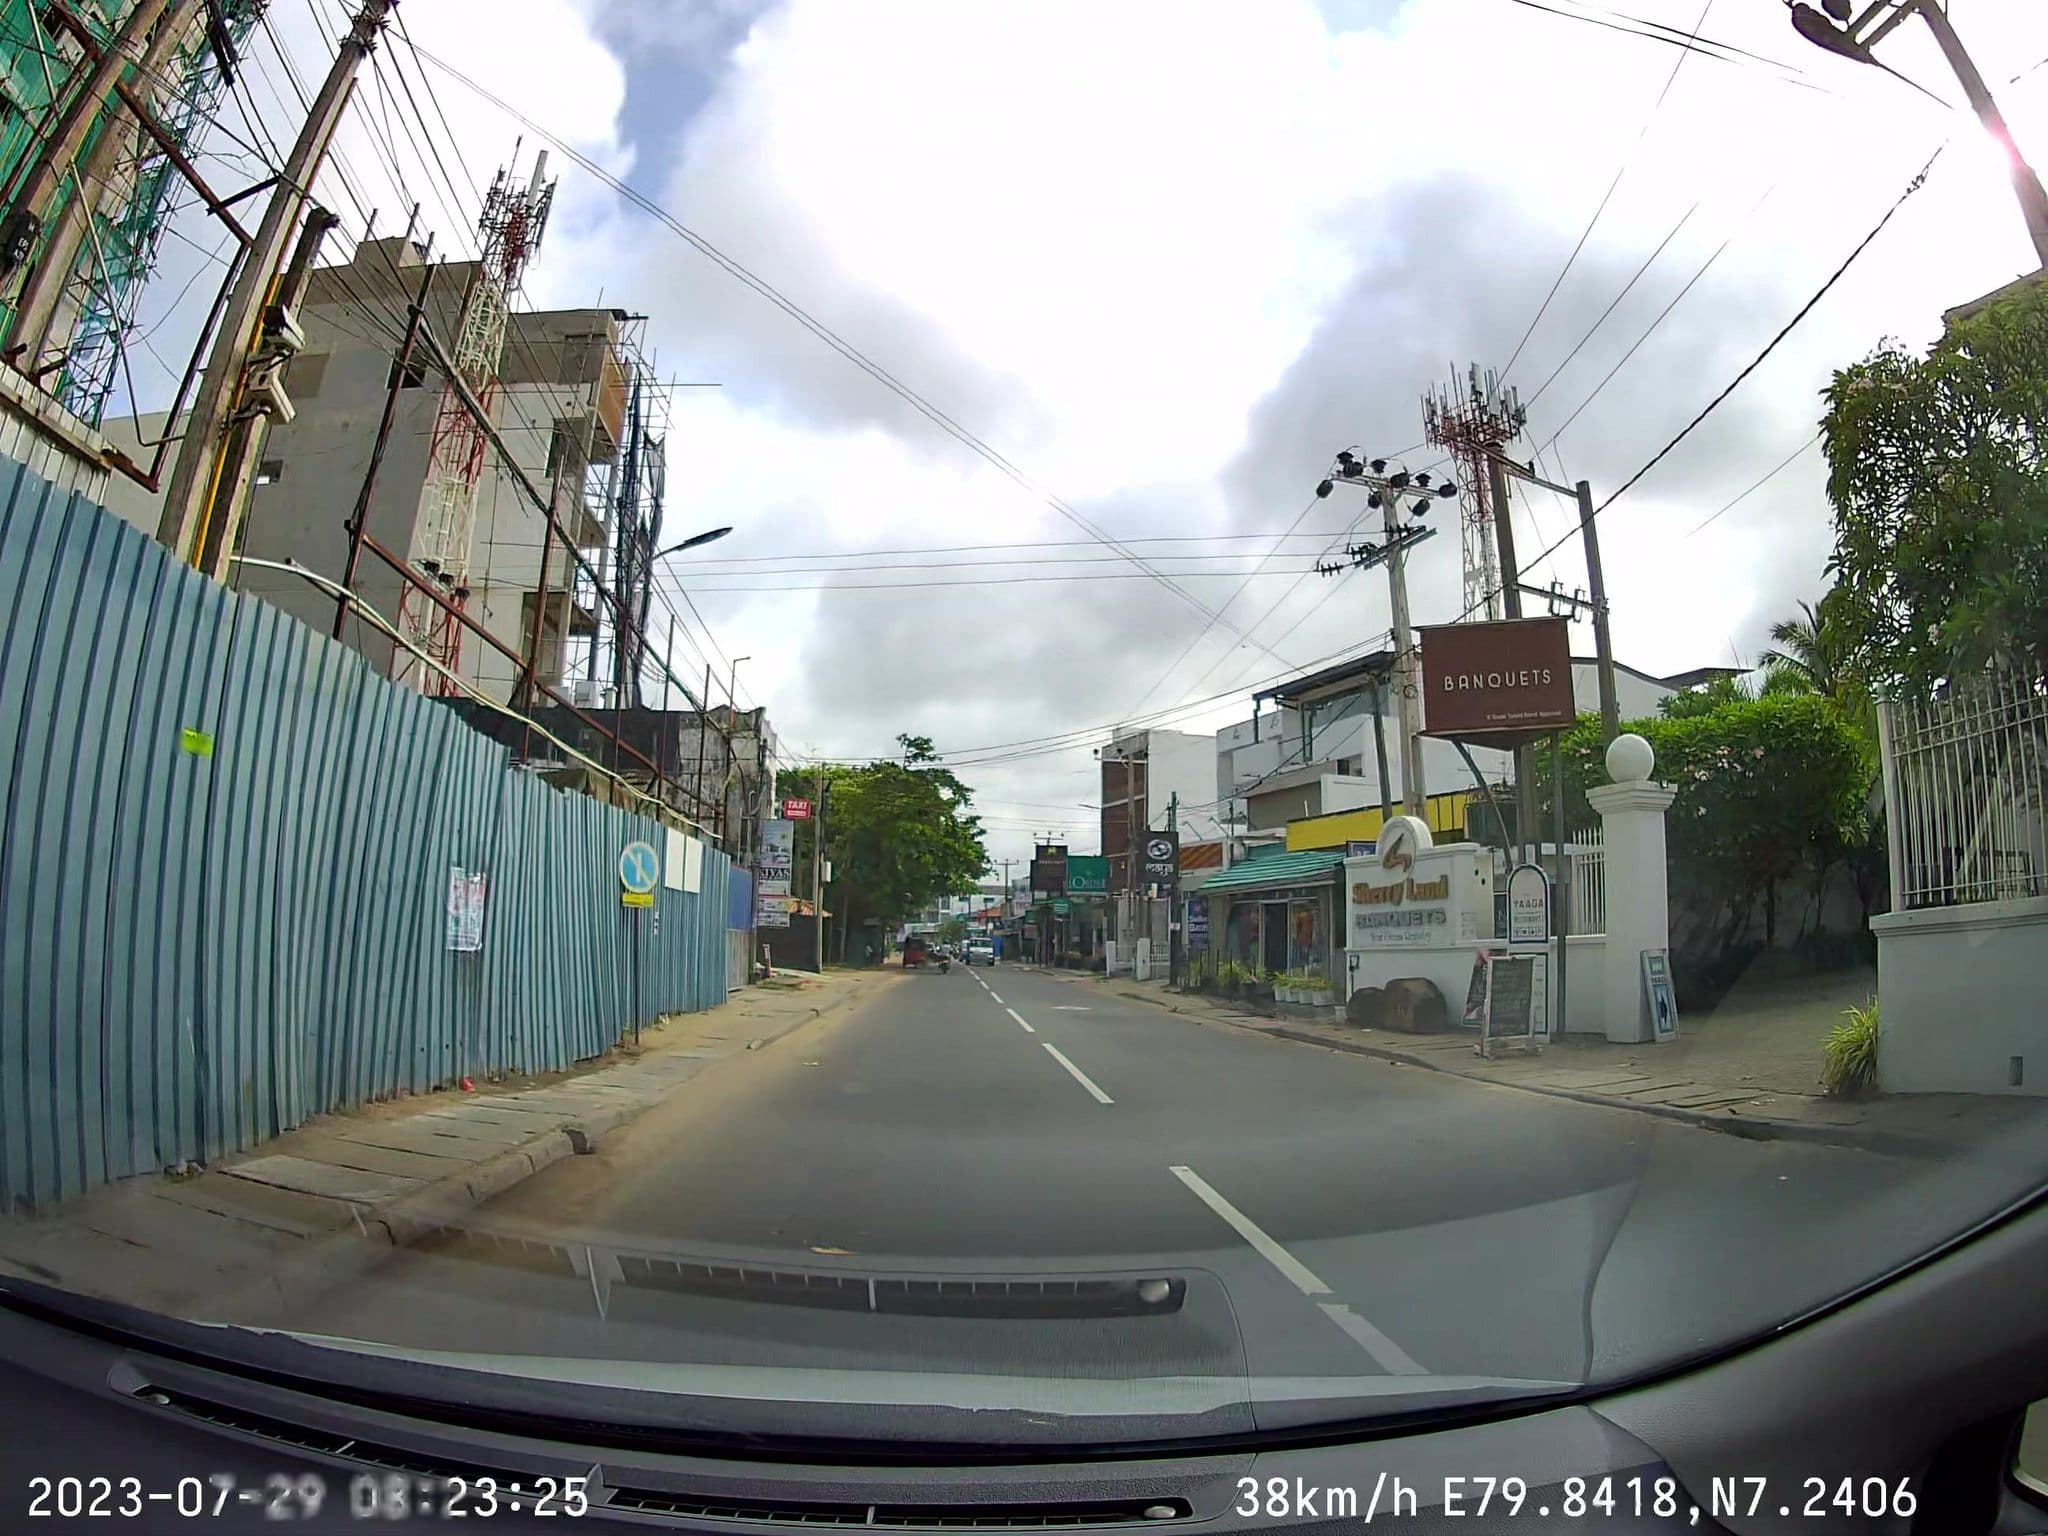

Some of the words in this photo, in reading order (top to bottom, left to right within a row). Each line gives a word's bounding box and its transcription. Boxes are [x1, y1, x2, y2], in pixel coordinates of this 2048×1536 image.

[1444, 669, 1551, 691] BANQUETS
[787, 800, 808, 809] TAXI
[1513, 898, 1543, 909] YAAGA
